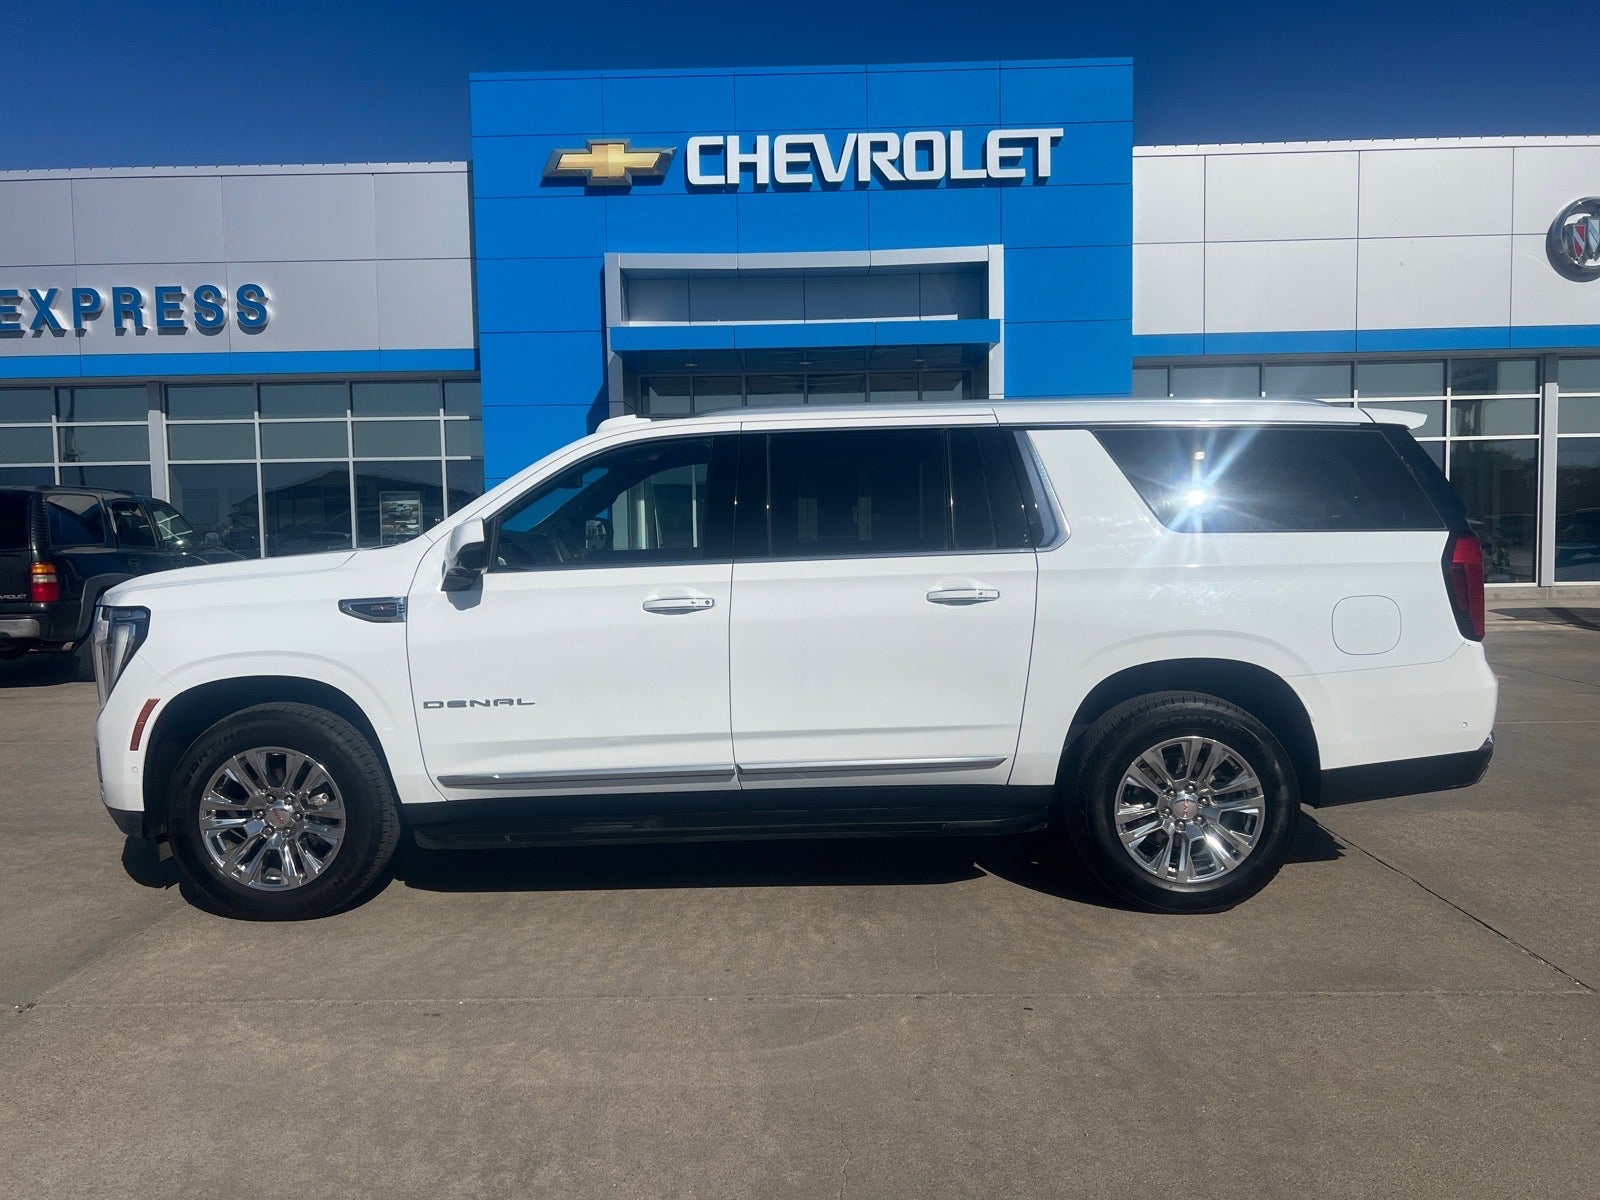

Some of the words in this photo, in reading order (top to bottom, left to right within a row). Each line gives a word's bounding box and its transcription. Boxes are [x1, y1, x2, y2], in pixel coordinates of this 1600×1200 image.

[686, 128, 1064, 186] CHEVROLET
[0, 283, 268, 330] EXPRESS
[423, 698, 535, 709] DENAL
